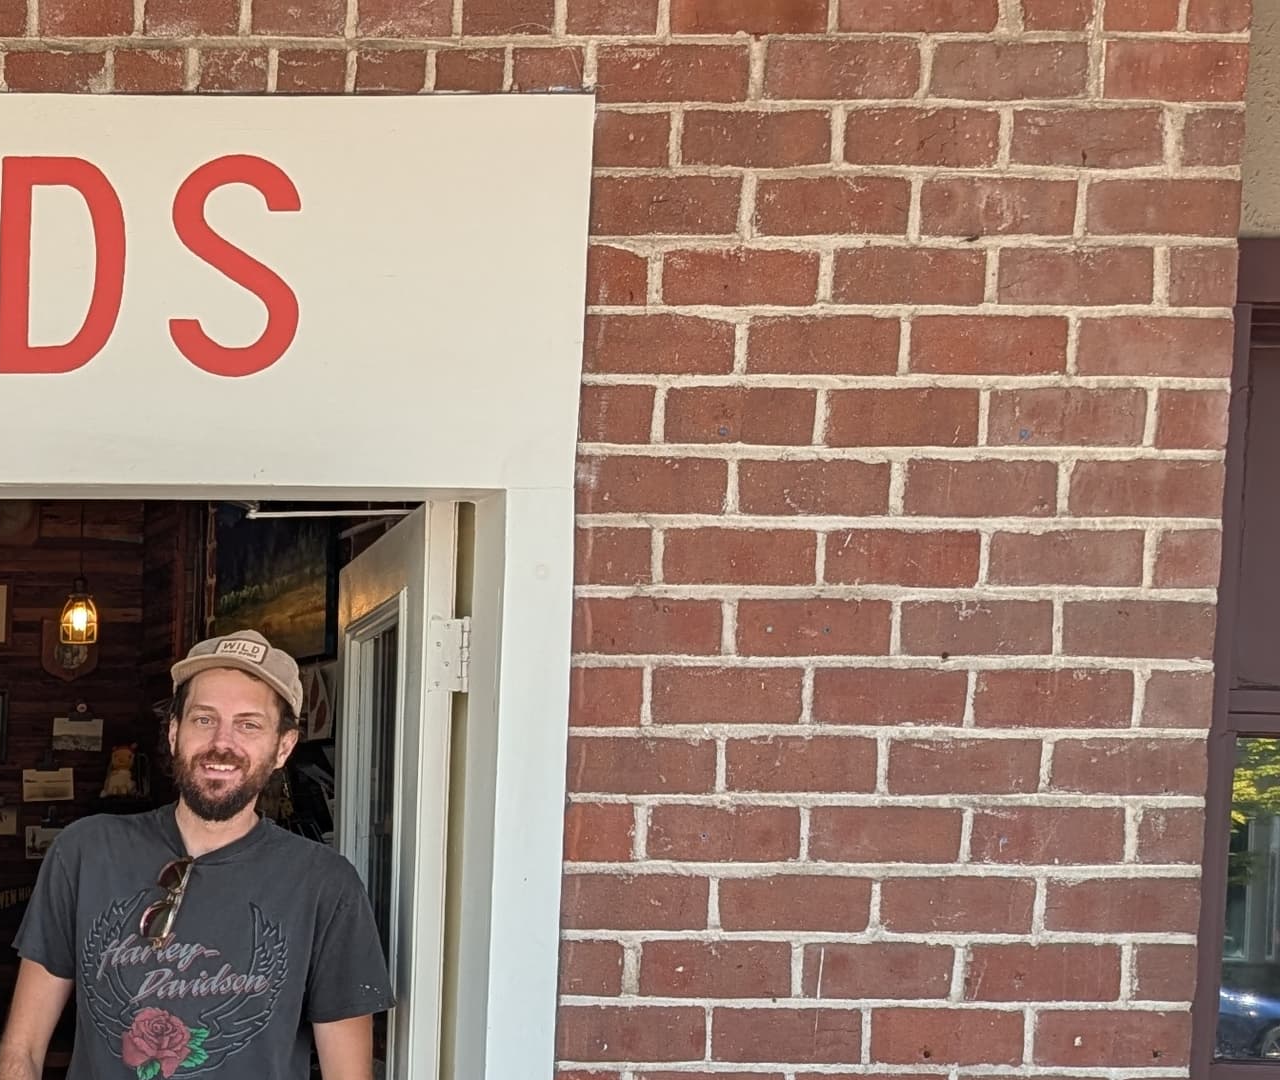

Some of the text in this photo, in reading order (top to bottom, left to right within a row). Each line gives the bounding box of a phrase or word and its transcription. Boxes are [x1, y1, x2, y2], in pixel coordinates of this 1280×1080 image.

[223, 642, 260, 654] WILD
[96, 932, 221, 980] Harley-
[128, 963, 271, 1005] Davidson
